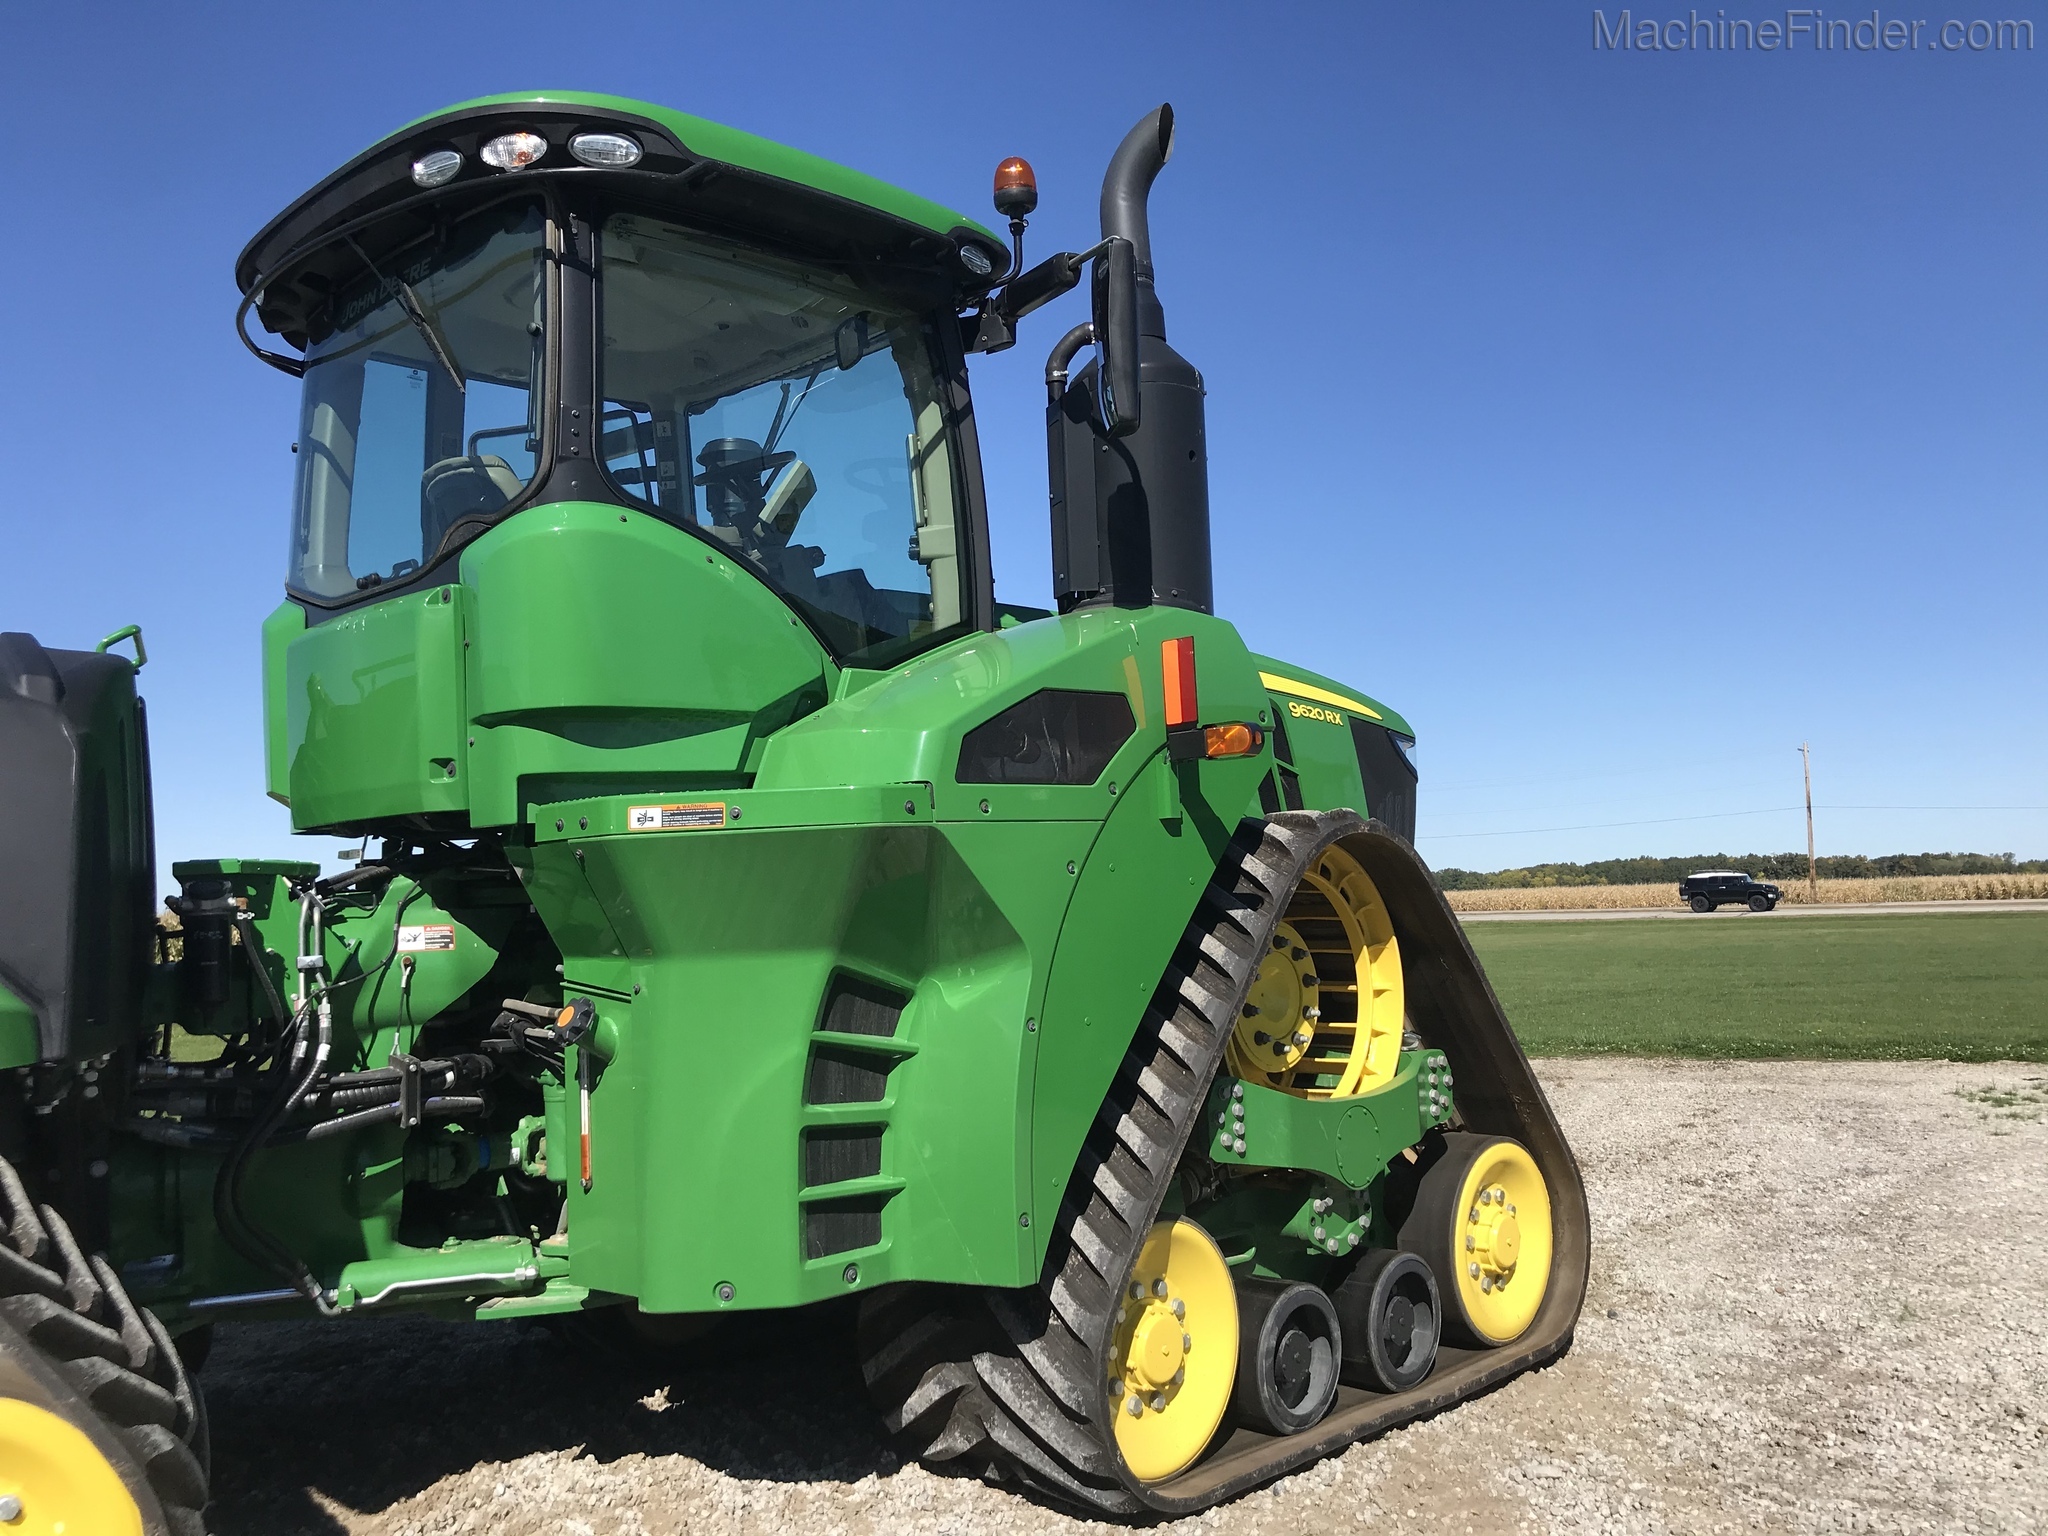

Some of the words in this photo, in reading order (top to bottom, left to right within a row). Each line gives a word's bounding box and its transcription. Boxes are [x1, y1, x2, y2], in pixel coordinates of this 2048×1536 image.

[341, 288, 377, 324] JOHN
[1288, 702, 1324, 721] 9620
[1325, 710, 1343, 726] RX
